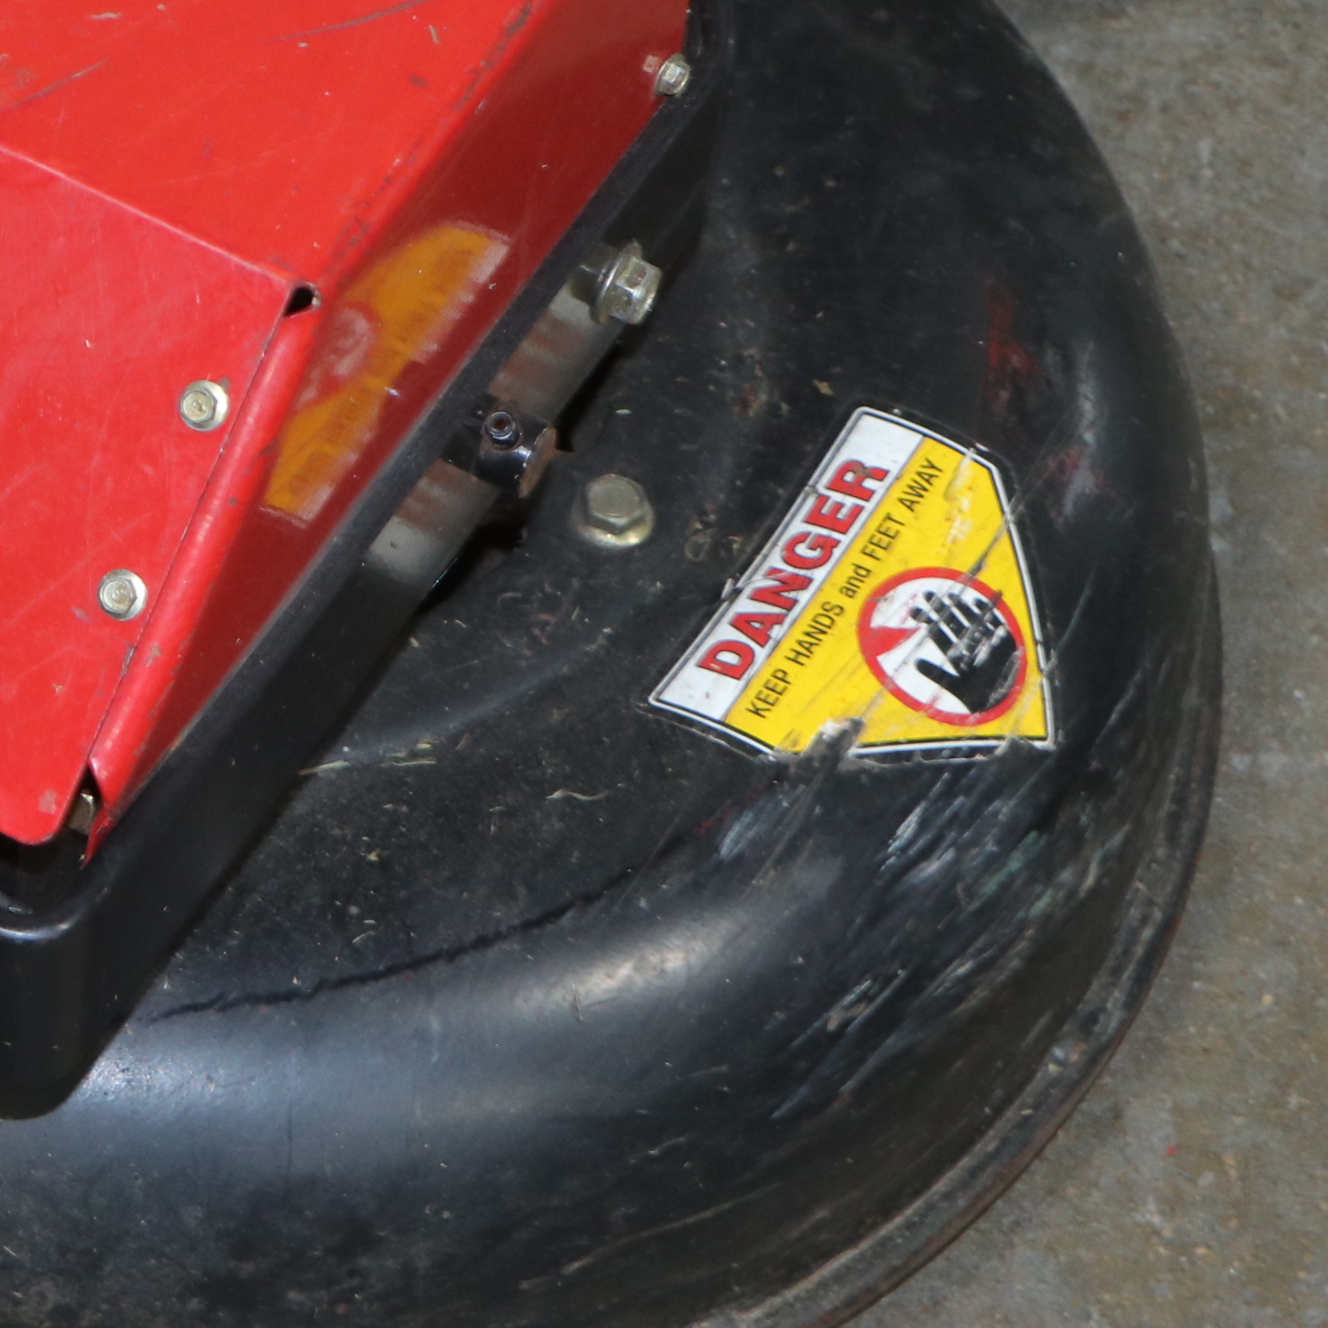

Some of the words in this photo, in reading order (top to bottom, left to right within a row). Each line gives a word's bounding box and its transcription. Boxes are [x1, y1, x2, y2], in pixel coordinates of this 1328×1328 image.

[697, 460, 890, 680] DANGER
[745, 668, 790, 719] KEEP
[787, 600, 845, 667] HANDS
[842, 562, 872, 599] and
[861, 511, 906, 562] FEET
[897, 458, 944, 512] AWAY
